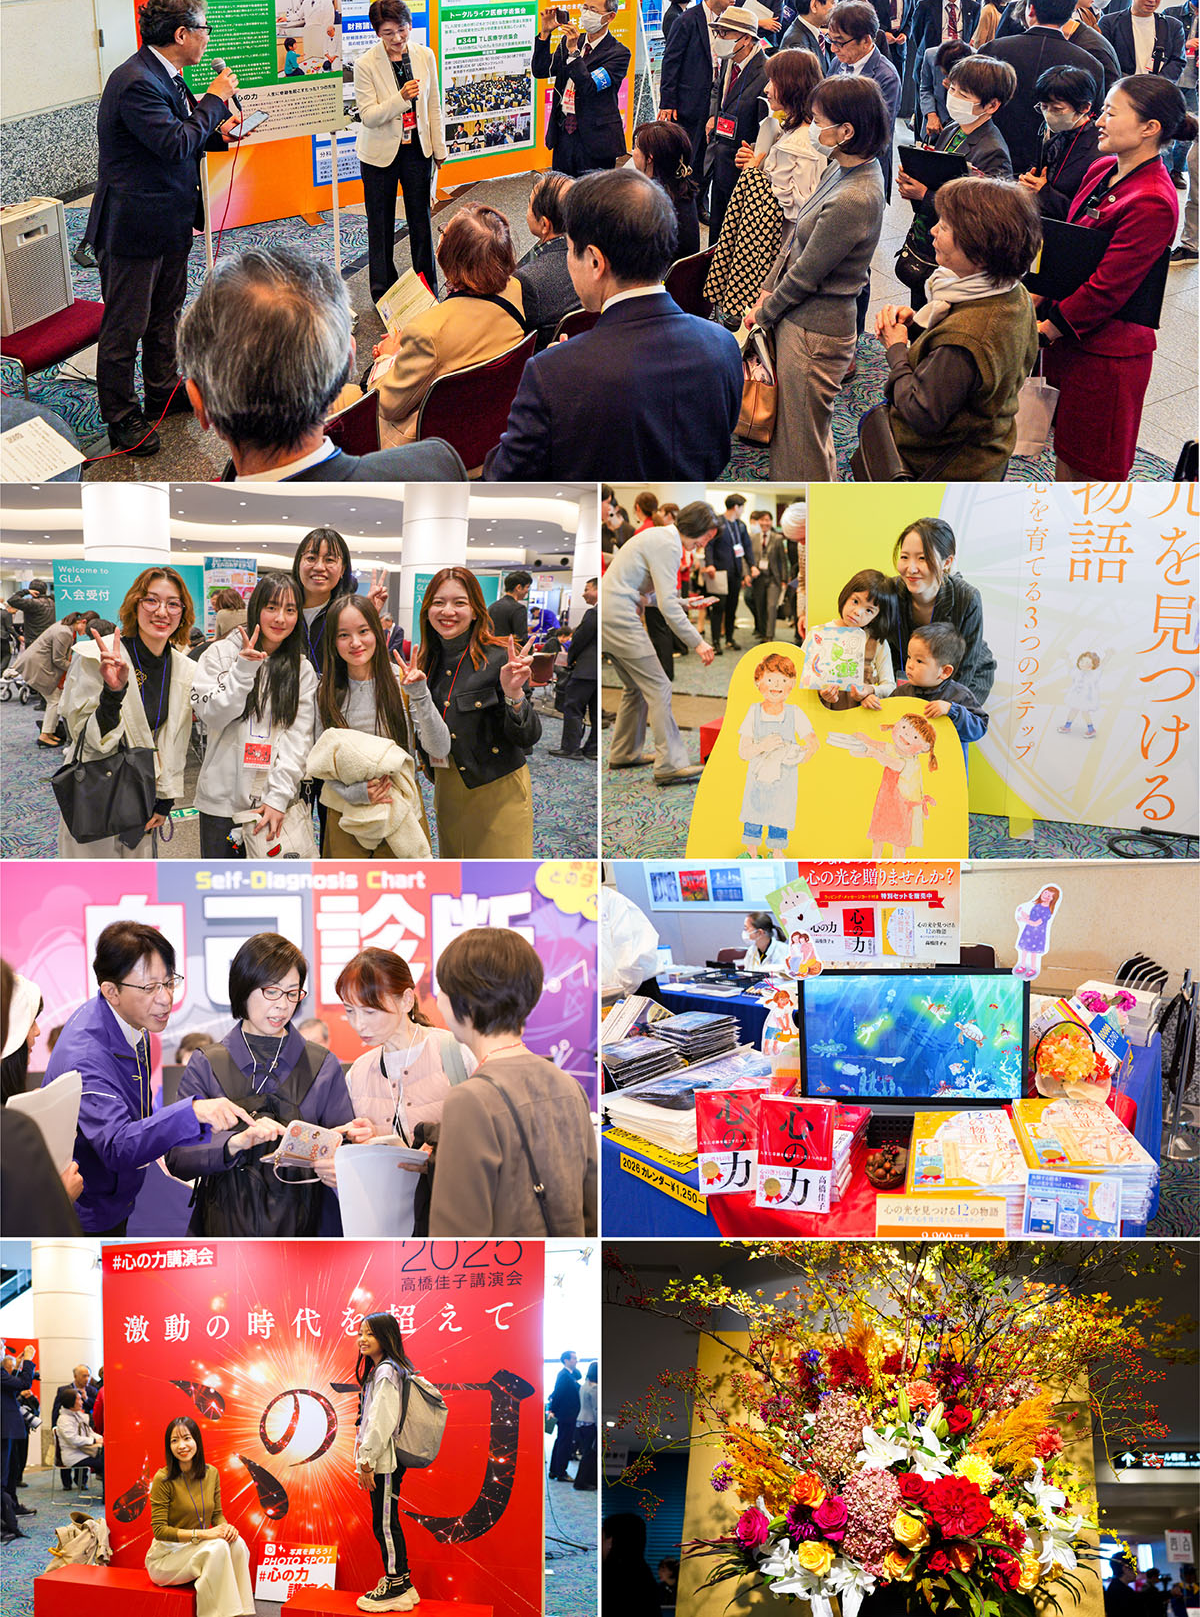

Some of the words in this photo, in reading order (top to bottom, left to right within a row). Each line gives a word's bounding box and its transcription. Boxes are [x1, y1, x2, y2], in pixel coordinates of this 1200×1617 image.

[58, 566, 98, 574] Welcome
[58, 575, 83, 583] GLA
[60, 589, 110, 601] 入会受付
[195, 871, 359, 891] Self-Diagnosis
[366, 870, 426, 890] Chart
[810, 921, 837, 933] 心の力
[849, 909, 866, 953] 心の力
[715, 1092, 752, 1190] 心の力
[773, 1104, 815, 1206] 心の力
[623, 1157, 641, 1174] 2026
[884, 1203, 999, 1217] 心の光を見つける12の物語
[112, 1247, 214, 1271] #心の力講演会
[401, 1241, 523, 1272] 2025
[401, 1270, 523, 1293] 高橋佳子講演会
[123, 1302, 514, 1344] 激動の時代を超えて
[263, 1557, 301, 1566] PHOTO
[303, 1555, 333, 1565] SPOT
[259, 1567, 310, 1583] #心の力
